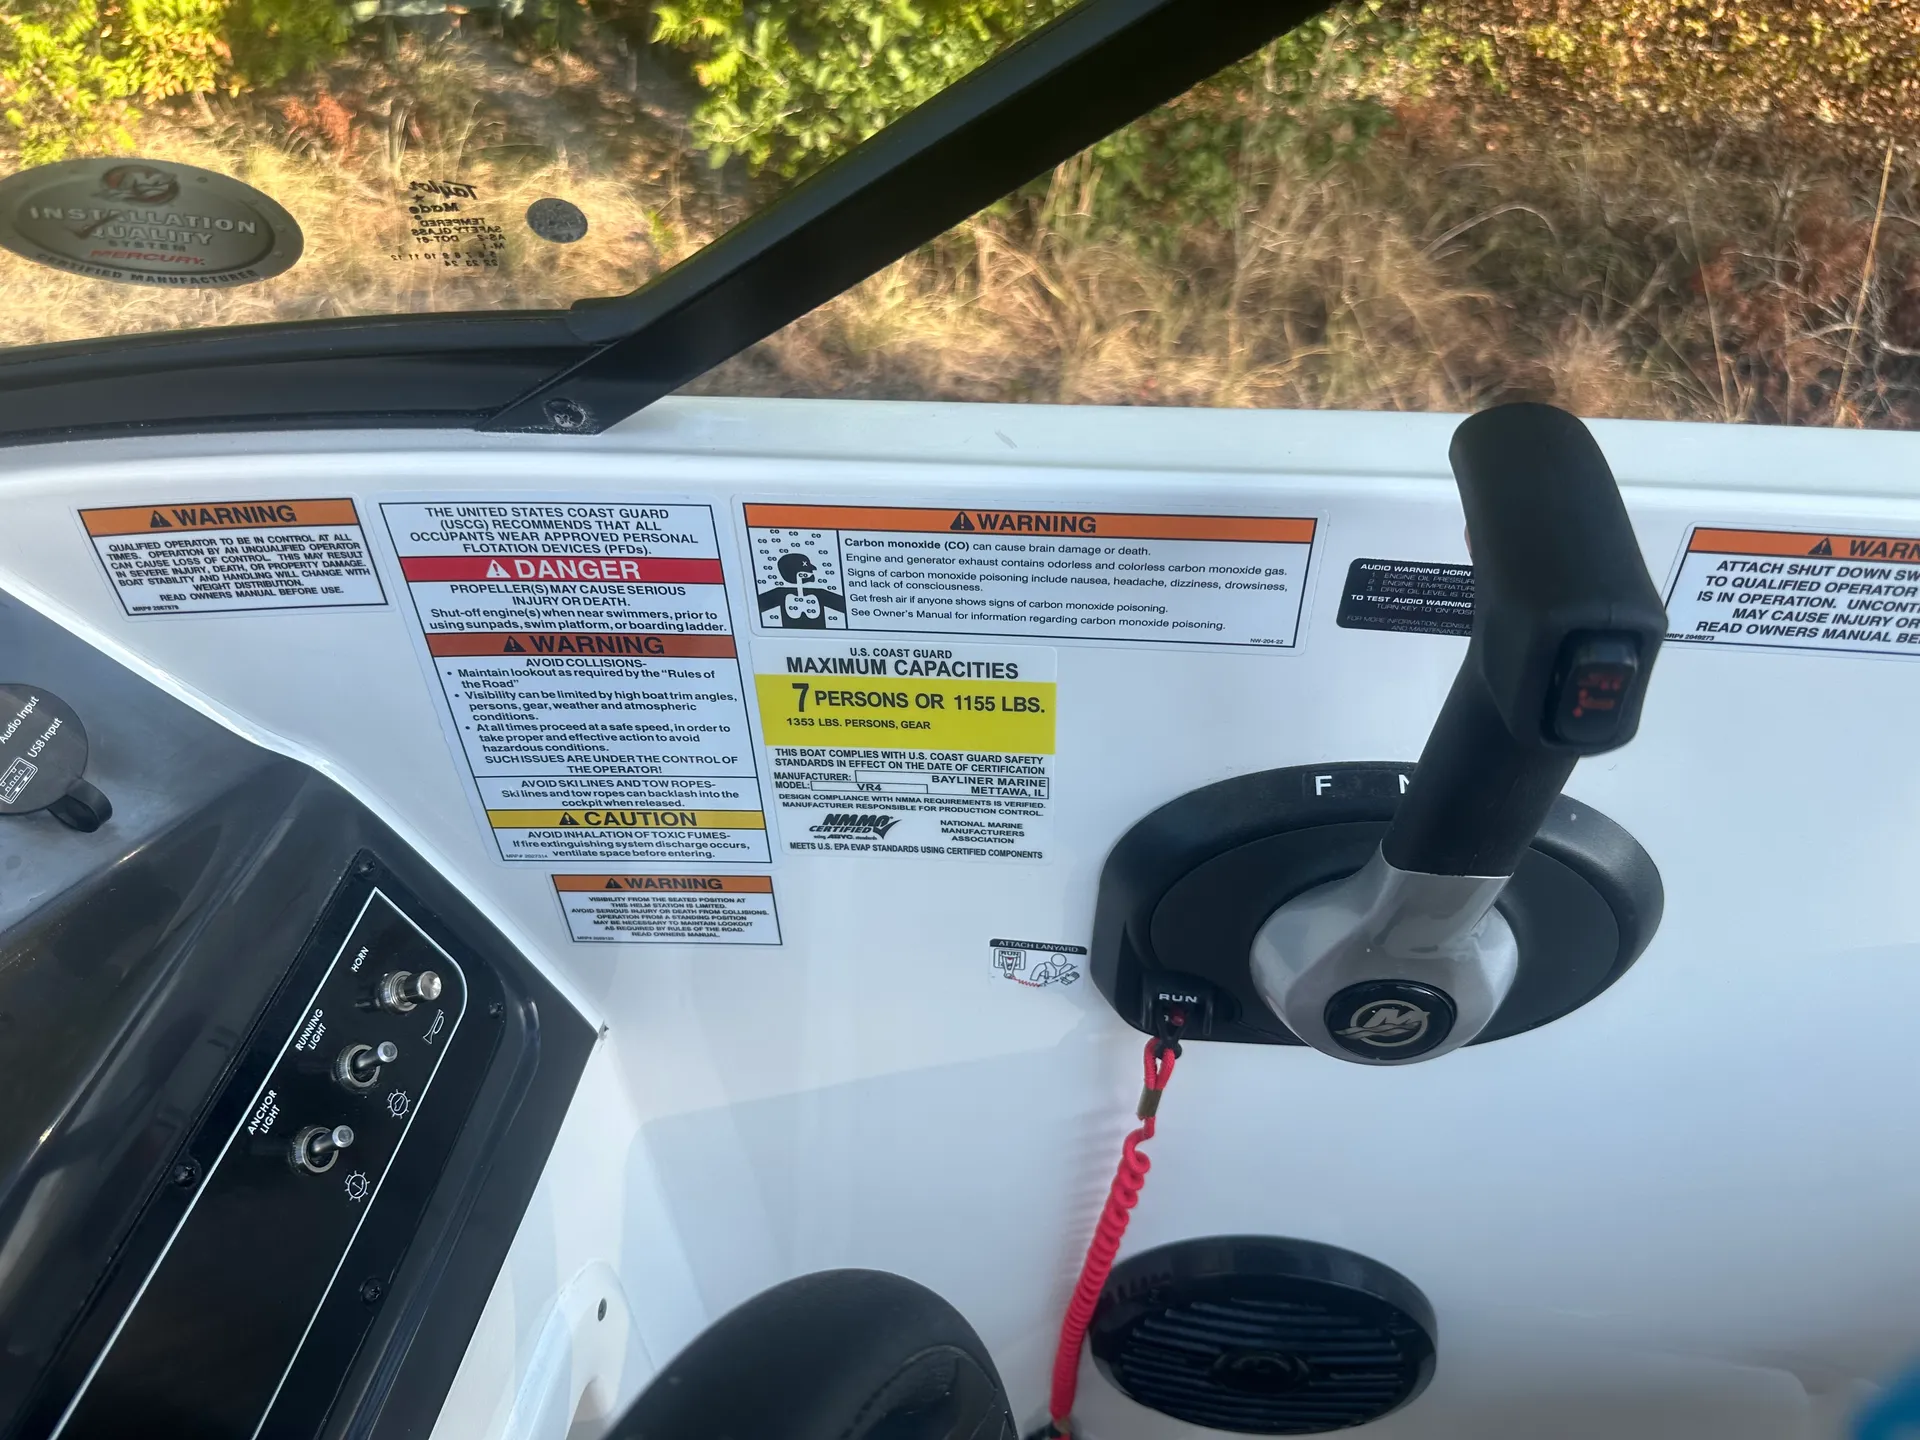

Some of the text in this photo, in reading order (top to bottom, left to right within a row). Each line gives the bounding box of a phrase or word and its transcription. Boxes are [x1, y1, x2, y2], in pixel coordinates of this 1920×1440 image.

[30, 207, 256, 234] INSTALLATION
[91, 224, 213, 245] QUALITY
[109, 240, 186, 252] SYSTEM
[131, 270, 259, 284] MANUFACTURER
[172, 505, 296, 526] WARNING
[425, 507, 669, 519] THE UNITED STATES COAST GUARD
[440, 519, 661, 531] (USCG) RECOMMENDS THAT ALL
[977, 513, 1097, 534] WARNING
[109, 541, 160, 552] QUALIFIED
[164, 538, 217, 548] OPERATOR
[220, 537, 233, 545] TO
[238, 536, 250, 544] BE
[268, 534, 315, 543] CONTROL
[318, 534, 329, 542] AT
[410, 532, 698, 544] OCCUPANTS WEAR APPROVED PERSONAL
[463, 543, 652, 556] FLOTATION DEVICES (PFDs).
[844, 538, 884, 549] Carbon
[888, 539, 941, 549] monoxide
[944, 540, 969, 551] (CO)
[973, 543, 991, 551] can
[995, 544, 1026, 552] cause
[1029, 544, 1055, 552] brain
[1058, 545, 1101, 556] damage
[1118, 547, 1151, 556] death.
[515, 559, 640, 580] DANGER
[846, 553, 1287, 577] Engine and generator exhaust contains odorless and colorless carbon monoxide gas.
[1394, 566, 1440, 574] WARNING
[1716, 561, 1784, 574] ATTACH
[1787, 563, 1834, 577] SHUT
[1837, 567, 1891, 580] DOWN
[160, 586, 344, 602] READ OWNERS MANUAL BEFORE USE.
[450, 584, 686, 596] PROPELLER(S) MAY CAUSE SERIOUS
[1706, 576, 1917, 597] TO QUALIFIED OPERATOR
[512, 596, 631, 607] INJURY OR DEATH.
[1426, 600, 1471, 608] WARNING
[1696, 591, 1713, 601] IS
[1717, 592, 1732, 602] IN
[1737, 593, 1836, 609] OPERATION.
[1732, 608, 1767, 620] MAY
[1771, 610, 1828, 623] CAUSE
[1832, 613, 1893, 628] INJURY
[1696, 622, 1920, 644] READ OWNERS MANUAL BE
[529, 635, 664, 654] WARNING
[850, 648, 952, 659] U.S. COAST GUARD
[526, 658, 647, 668] AVOID COLLISIONS-
[786, 657, 1018, 679] MAXIMUM CAPACITIES
[792, 683, 1045, 713] 7 PERSONS OR 1155 LBS.
[0, 696, 39, 744] Audio Input
[786, 718, 930, 729] 1353 LBS. PERSONS, GEAR
[28, 718, 62, 758] USB Input
[800, 749, 826, 757] BOAT
[829, 750, 878, 758] COMPLIES
[881, 751, 905, 759] WITH
[909, 752, 927, 760] U.S.
[930, 753, 963, 761] COAST
[966, 754, 1002, 763] GUARD
[1005, 756, 1043, 764] SAFETY
[774, 772, 1046, 787] MANUFACTURER: BAYLINER MARINE
[1315, 775, 1332, 796] F
[776, 781, 1044, 797] MODEL: VR4 METTAWA, IL
[584, 812, 697, 827] CAUTION
[822, 814, 888, 827] NMMA
[940, 820, 985, 828] NATIONAL
[941, 827, 1024, 837] MANUFACTURERS
[951, 835, 1014, 844] ASSOCIATION
[625, 878, 723, 890] WARNING
[1035, 944, 1078, 953] LANYARD
[351, 946, 369, 972] HORN
[1159, 993, 1198, 1003] RUN
[295, 1008, 324, 1051] RUNNING
[308, 1023, 327, 1050] LIGHT
[247, 1090, 277, 1135] ANCHOR
[260, 1105, 280, 1134] LIGHT
